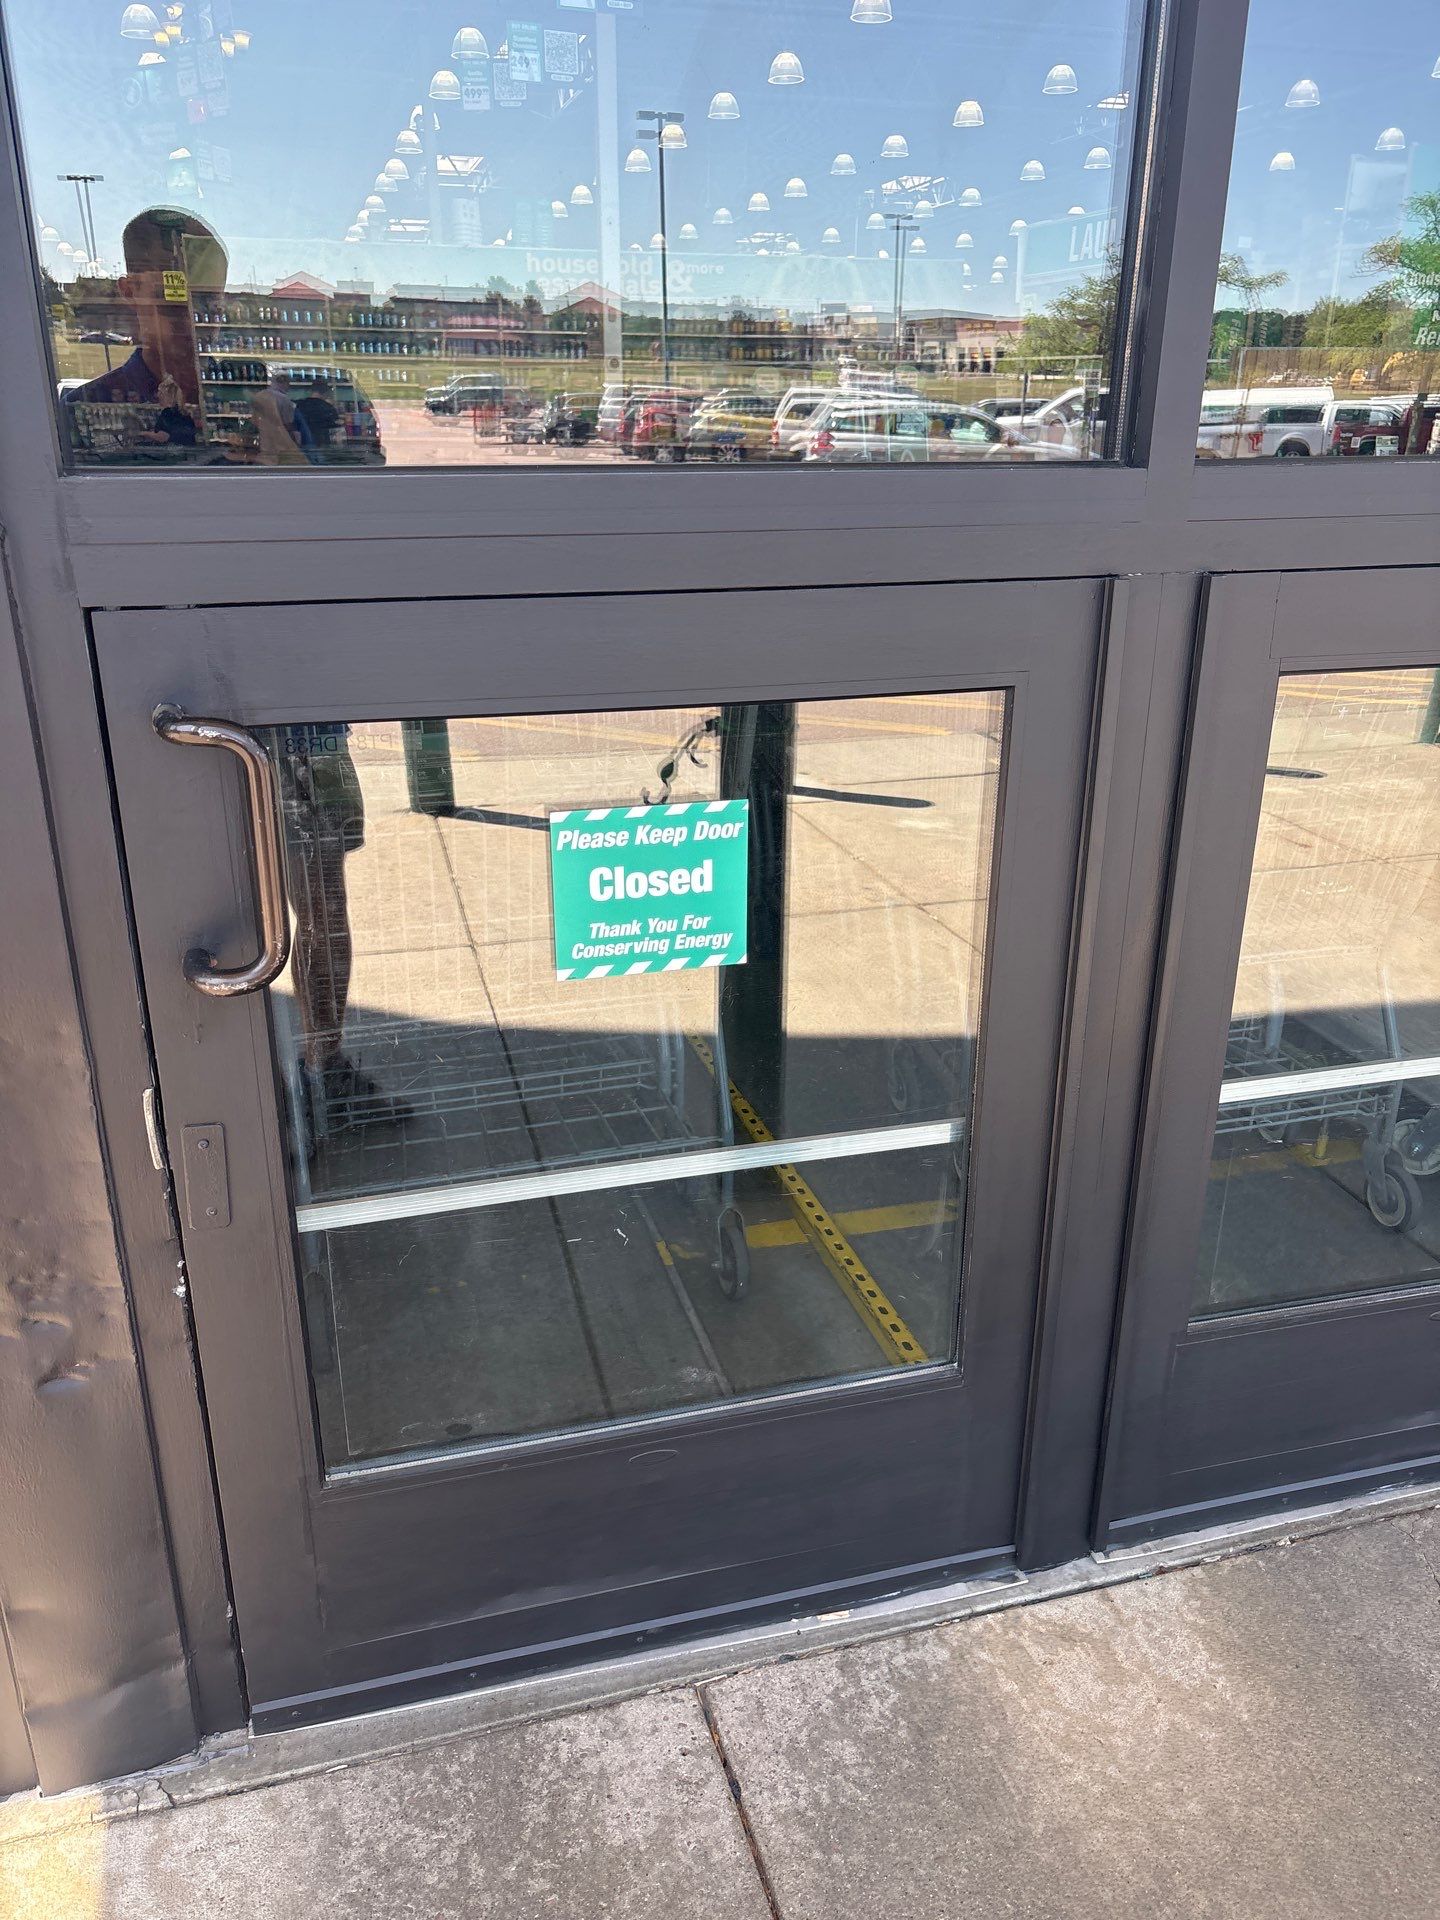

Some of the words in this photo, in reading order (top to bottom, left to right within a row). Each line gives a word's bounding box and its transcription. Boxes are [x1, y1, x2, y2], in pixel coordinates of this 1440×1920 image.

[686, 263, 724, 275] more
[556, 829, 629, 851] Please
[635, 824, 688, 847] Keep
[693, 820, 744, 841] Door
[589, 859, 713, 902] Closed
[589, 920, 642, 939] Thank
[648, 918, 678, 933] You
[682, 914, 711, 931] For
[572, 937, 670, 960] Conserving
[674, 932, 733, 949] Energy
